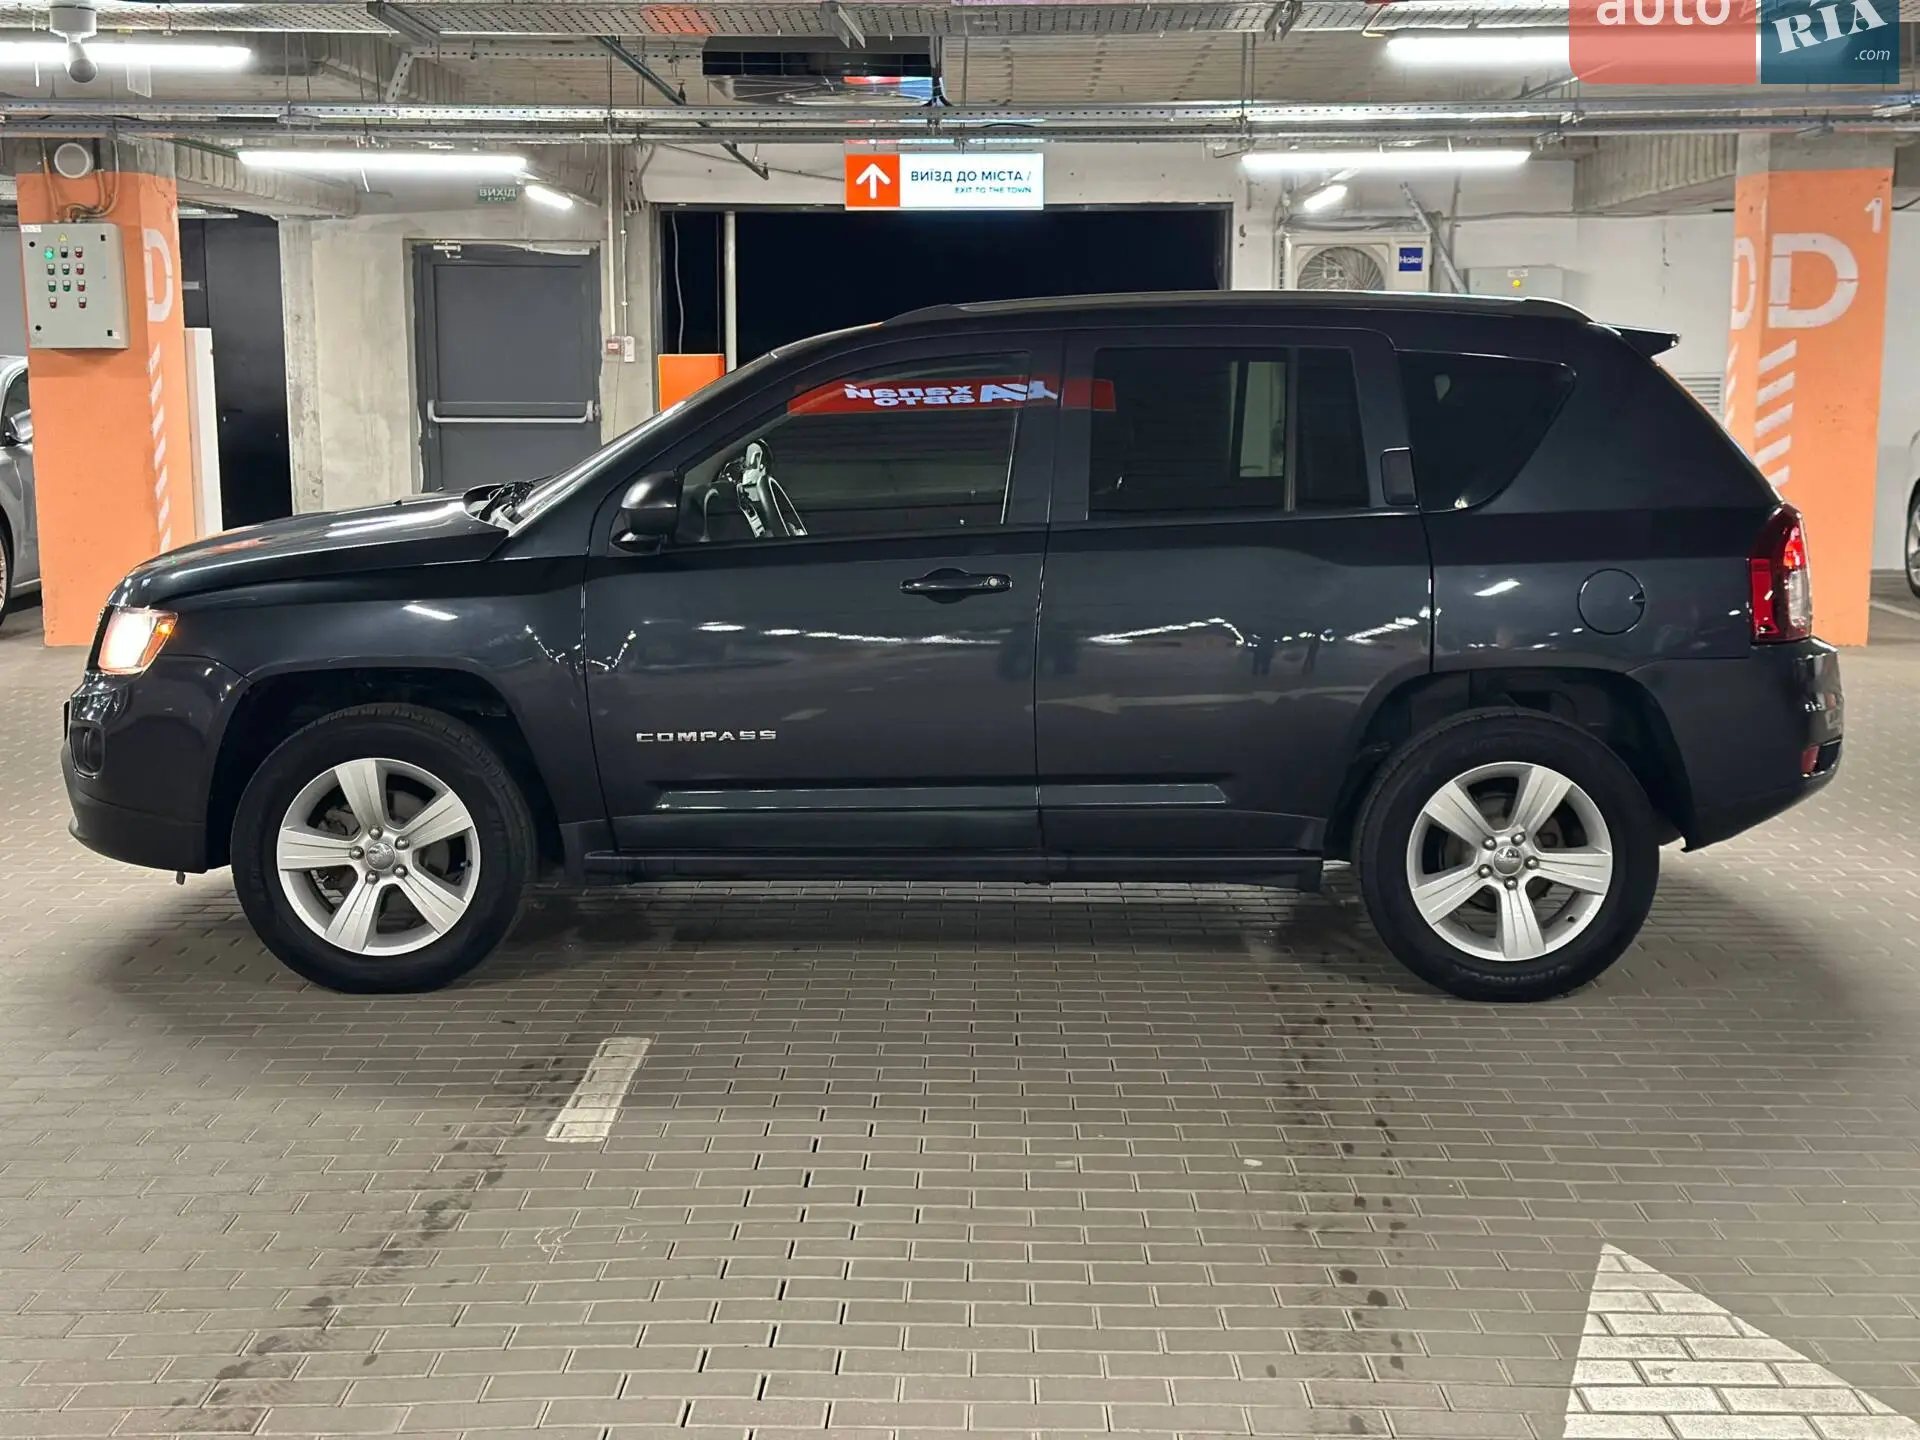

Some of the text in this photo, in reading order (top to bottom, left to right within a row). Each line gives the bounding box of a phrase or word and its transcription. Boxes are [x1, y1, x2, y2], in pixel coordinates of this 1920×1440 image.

[911, 169, 952, 182] ВИЇЗД
[957, 171, 978, 182] ДО
[981, 171, 1024, 181] МІСТА
[1863, 197, 1883, 234] 1
[1399, 255, 1423, 264] Haier
[143, 228, 174, 322] D
[1768, 232, 1859, 328] D
[636, 730, 776, 742] COMPASS
